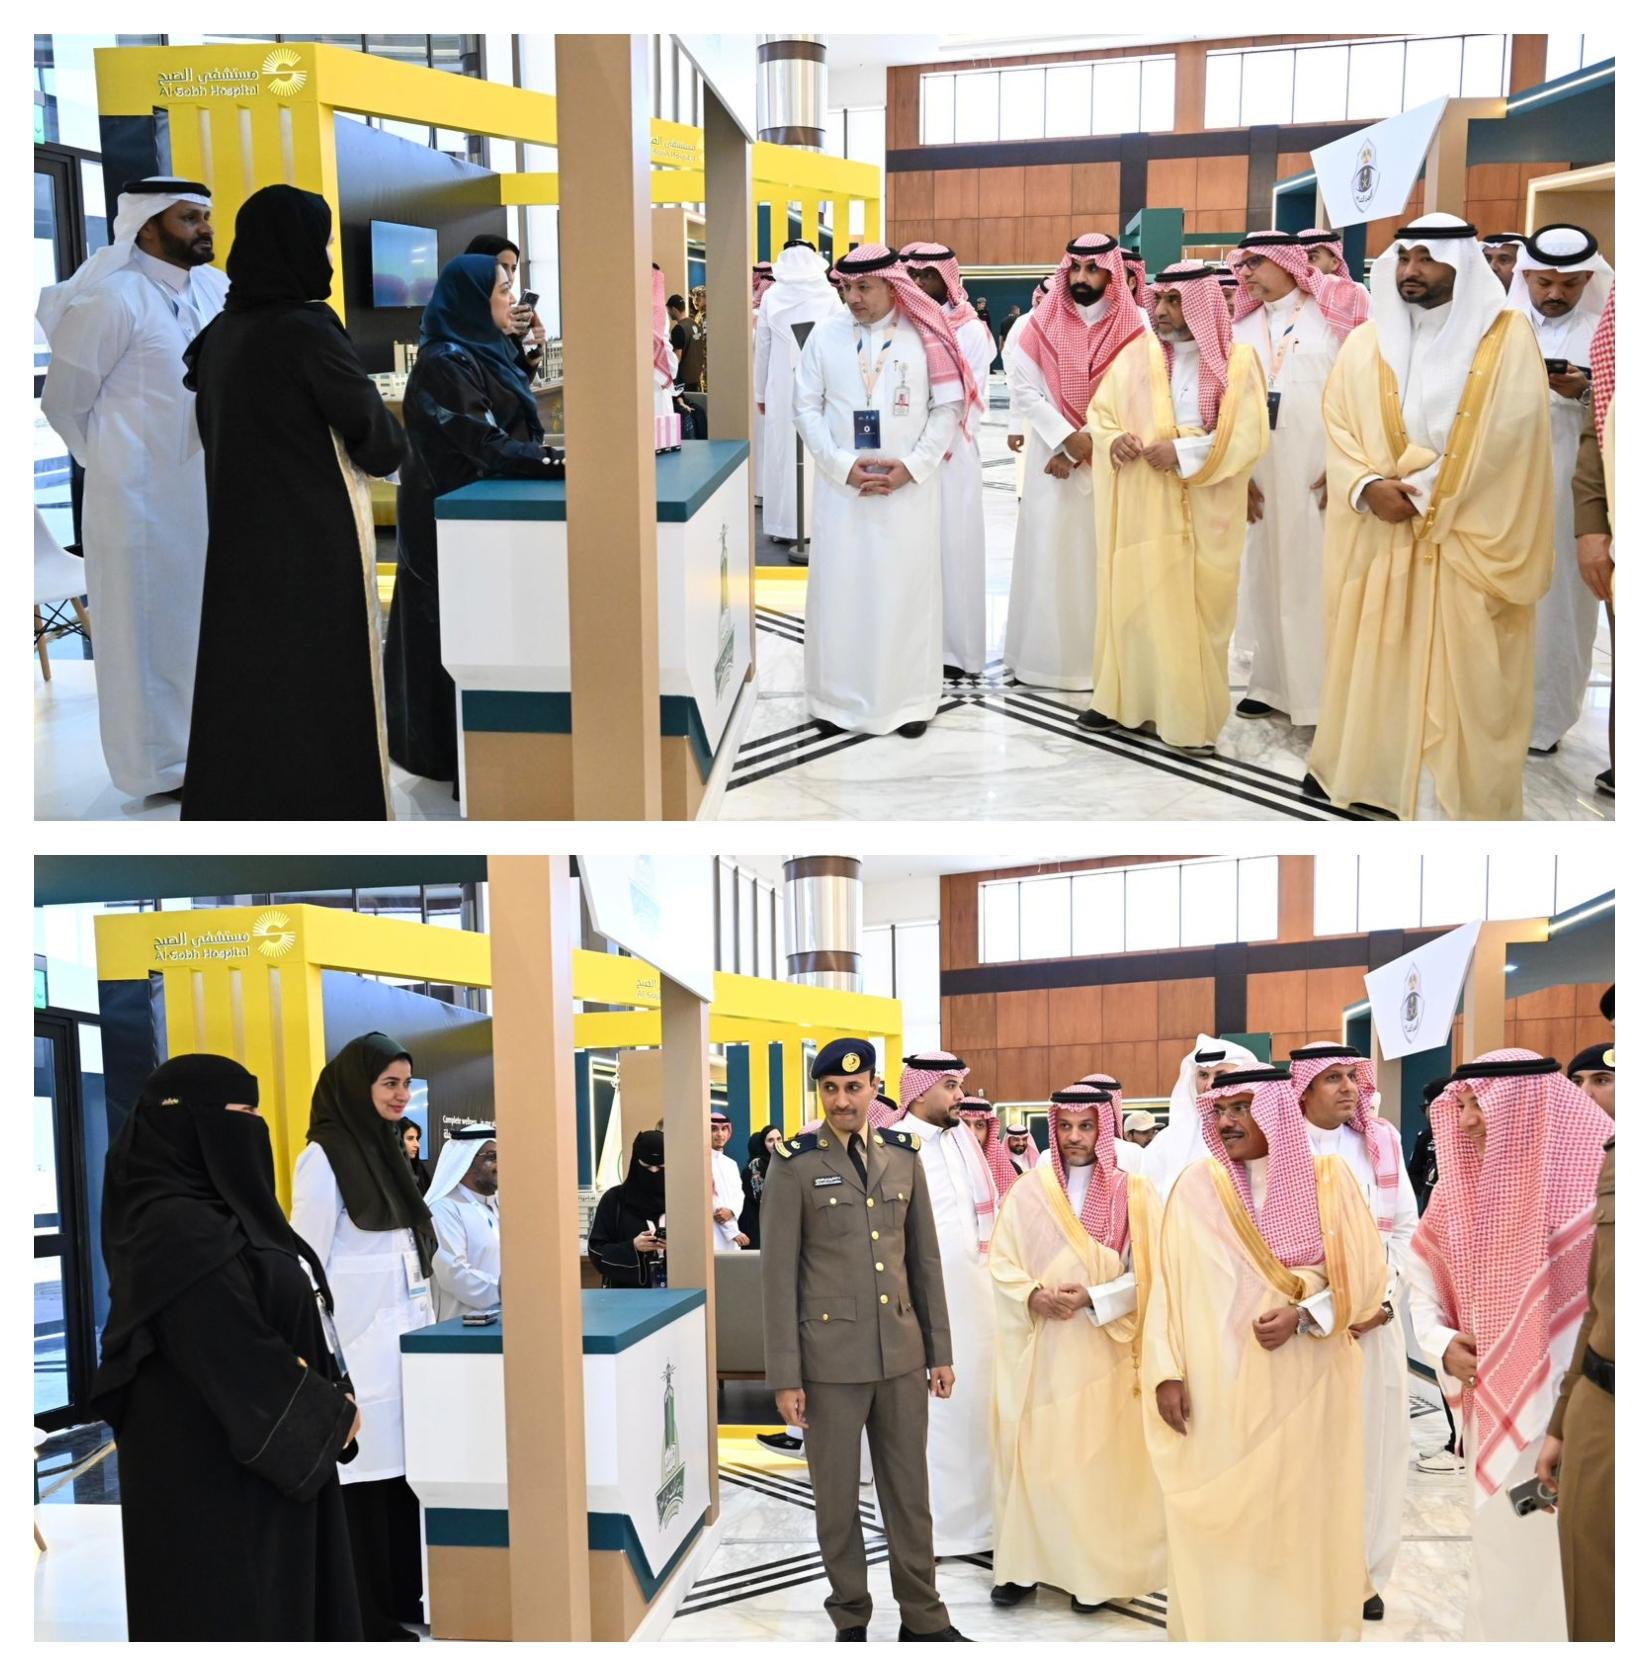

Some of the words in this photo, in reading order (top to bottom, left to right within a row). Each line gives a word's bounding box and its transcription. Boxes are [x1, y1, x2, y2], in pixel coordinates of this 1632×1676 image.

[210, 84, 260, 98] Hospital
[203, 946, 250, 960] Hospital
[442, 1114, 461, 1126] Complete
